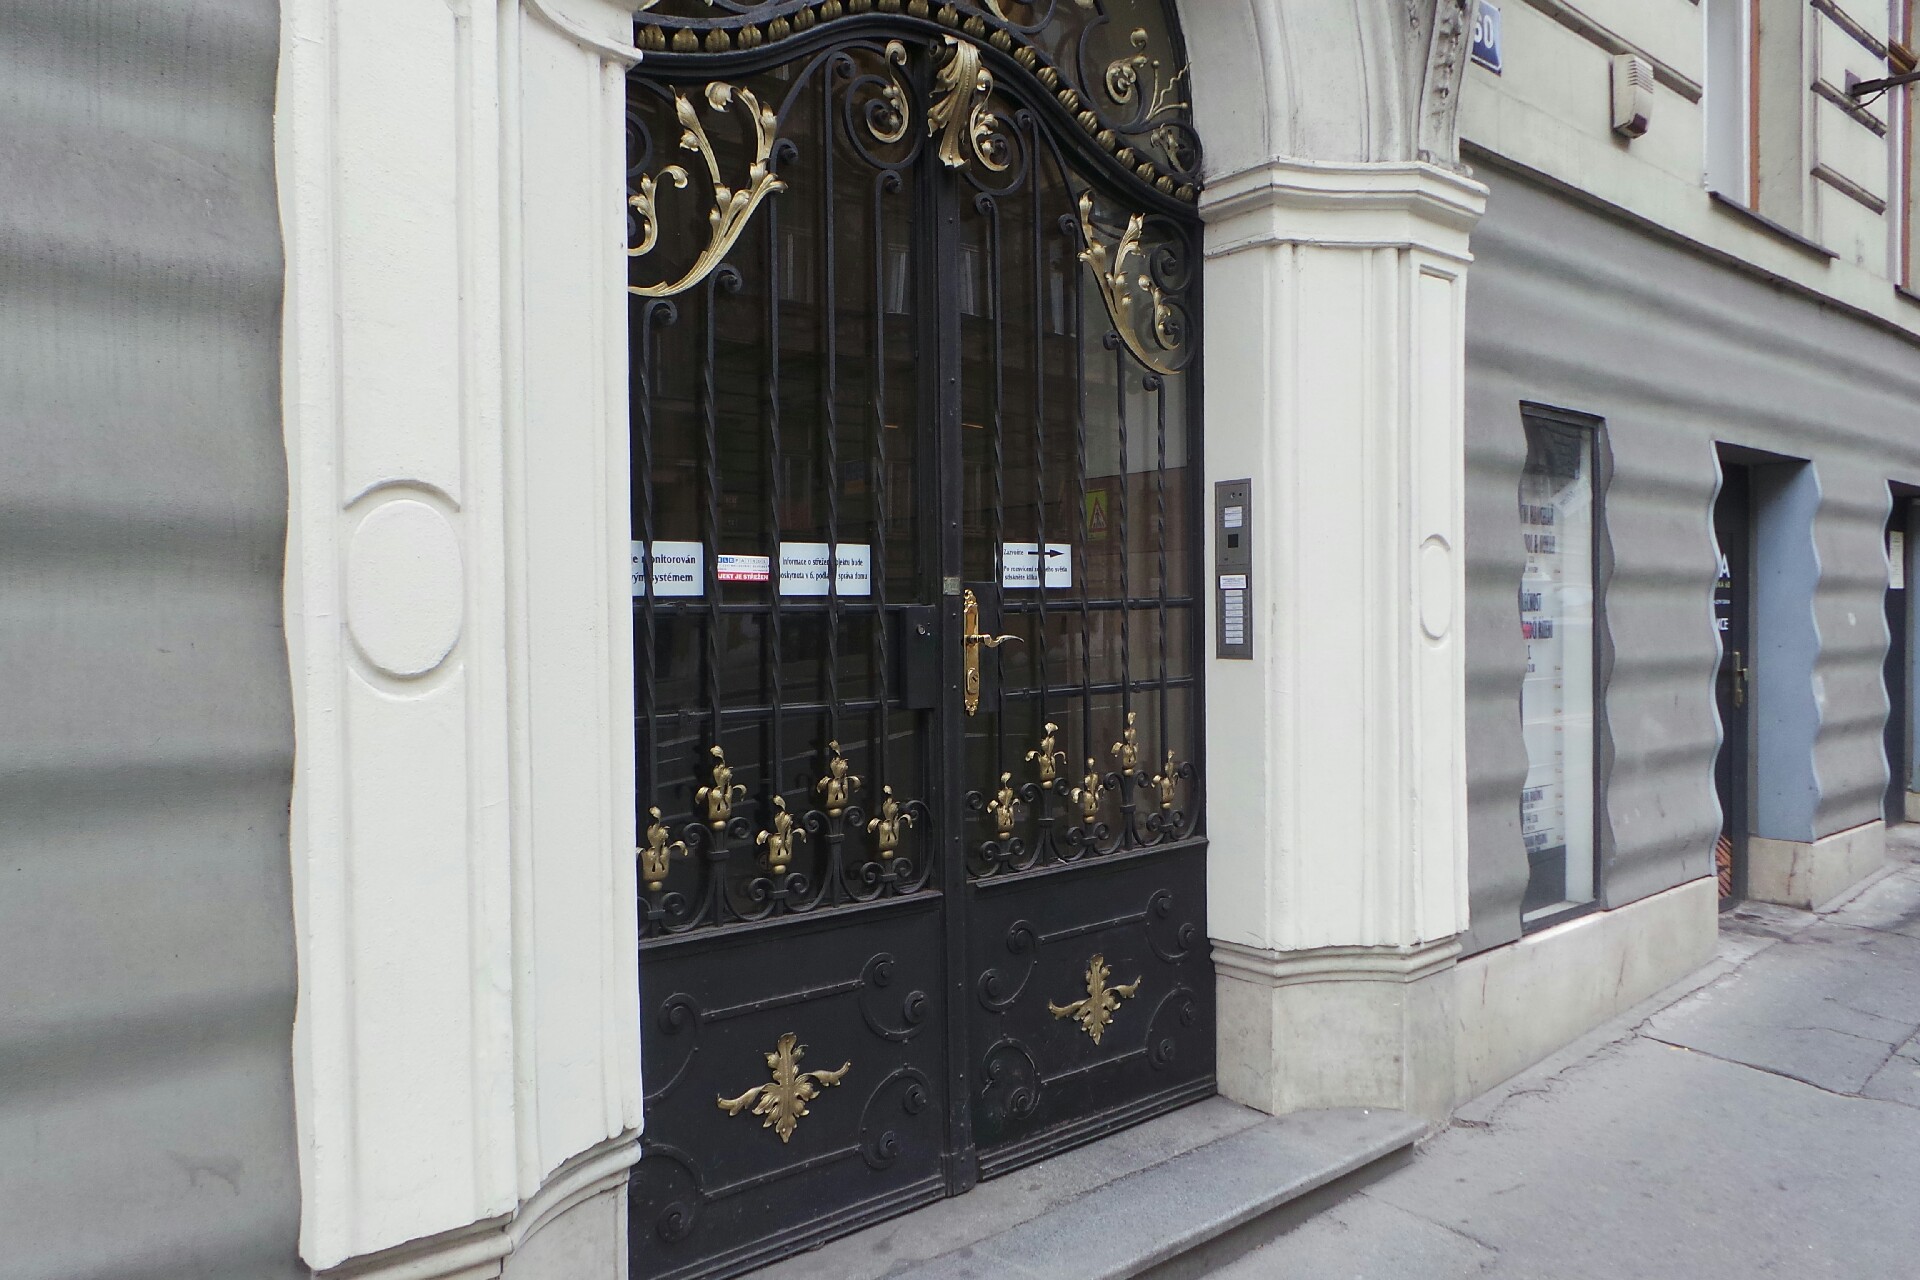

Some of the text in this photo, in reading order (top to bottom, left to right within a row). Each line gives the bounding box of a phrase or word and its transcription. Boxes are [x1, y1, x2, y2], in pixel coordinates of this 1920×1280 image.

[783, 557, 807, 566] Informace
[780, 571, 804, 581] oskytnuta
[838, 572, 853, 582] správa
